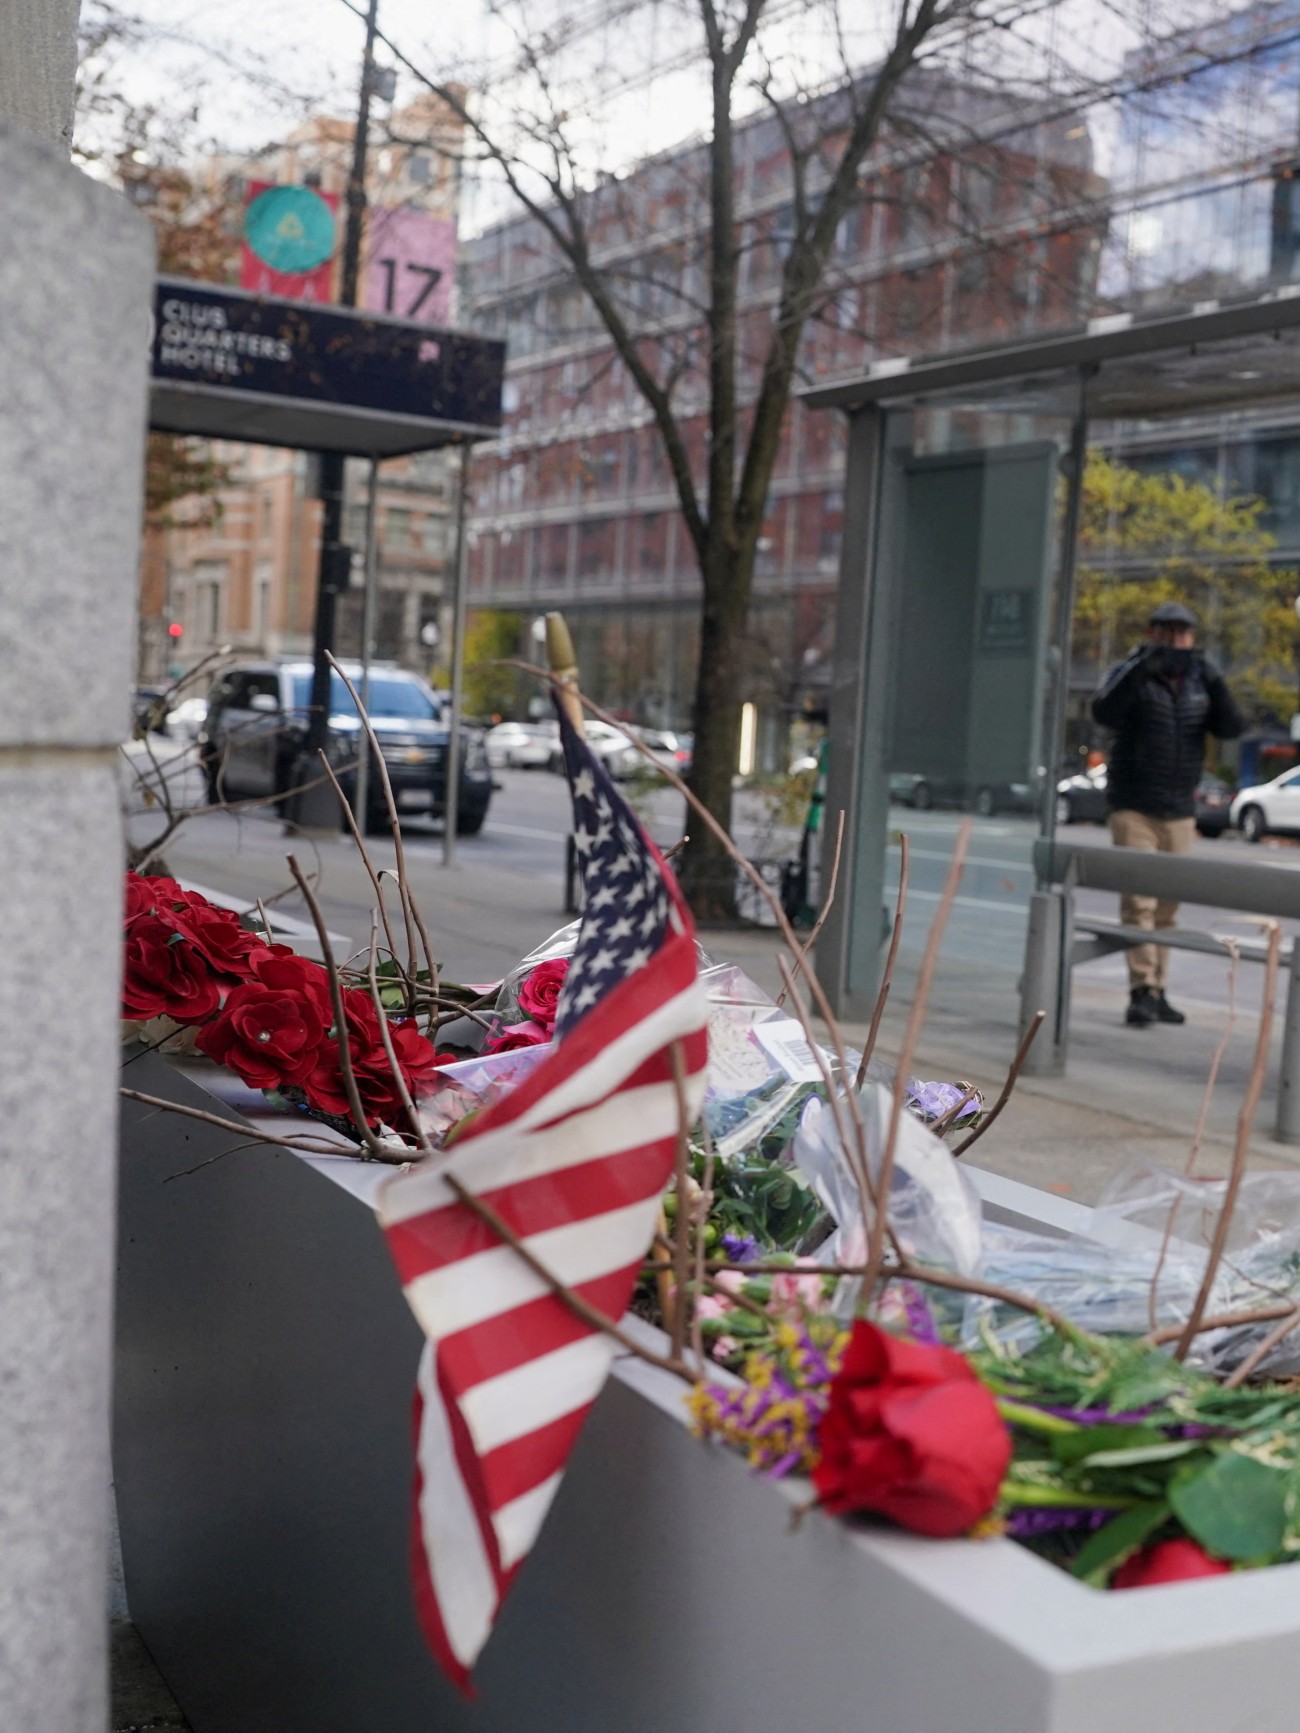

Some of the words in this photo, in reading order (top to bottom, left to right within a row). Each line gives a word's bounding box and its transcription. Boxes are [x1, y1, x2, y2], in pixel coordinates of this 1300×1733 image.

[380, 258, 442, 316] 17
[161, 320, 292, 362] QUARTERS
[161, 345, 242, 375] HOTEL
